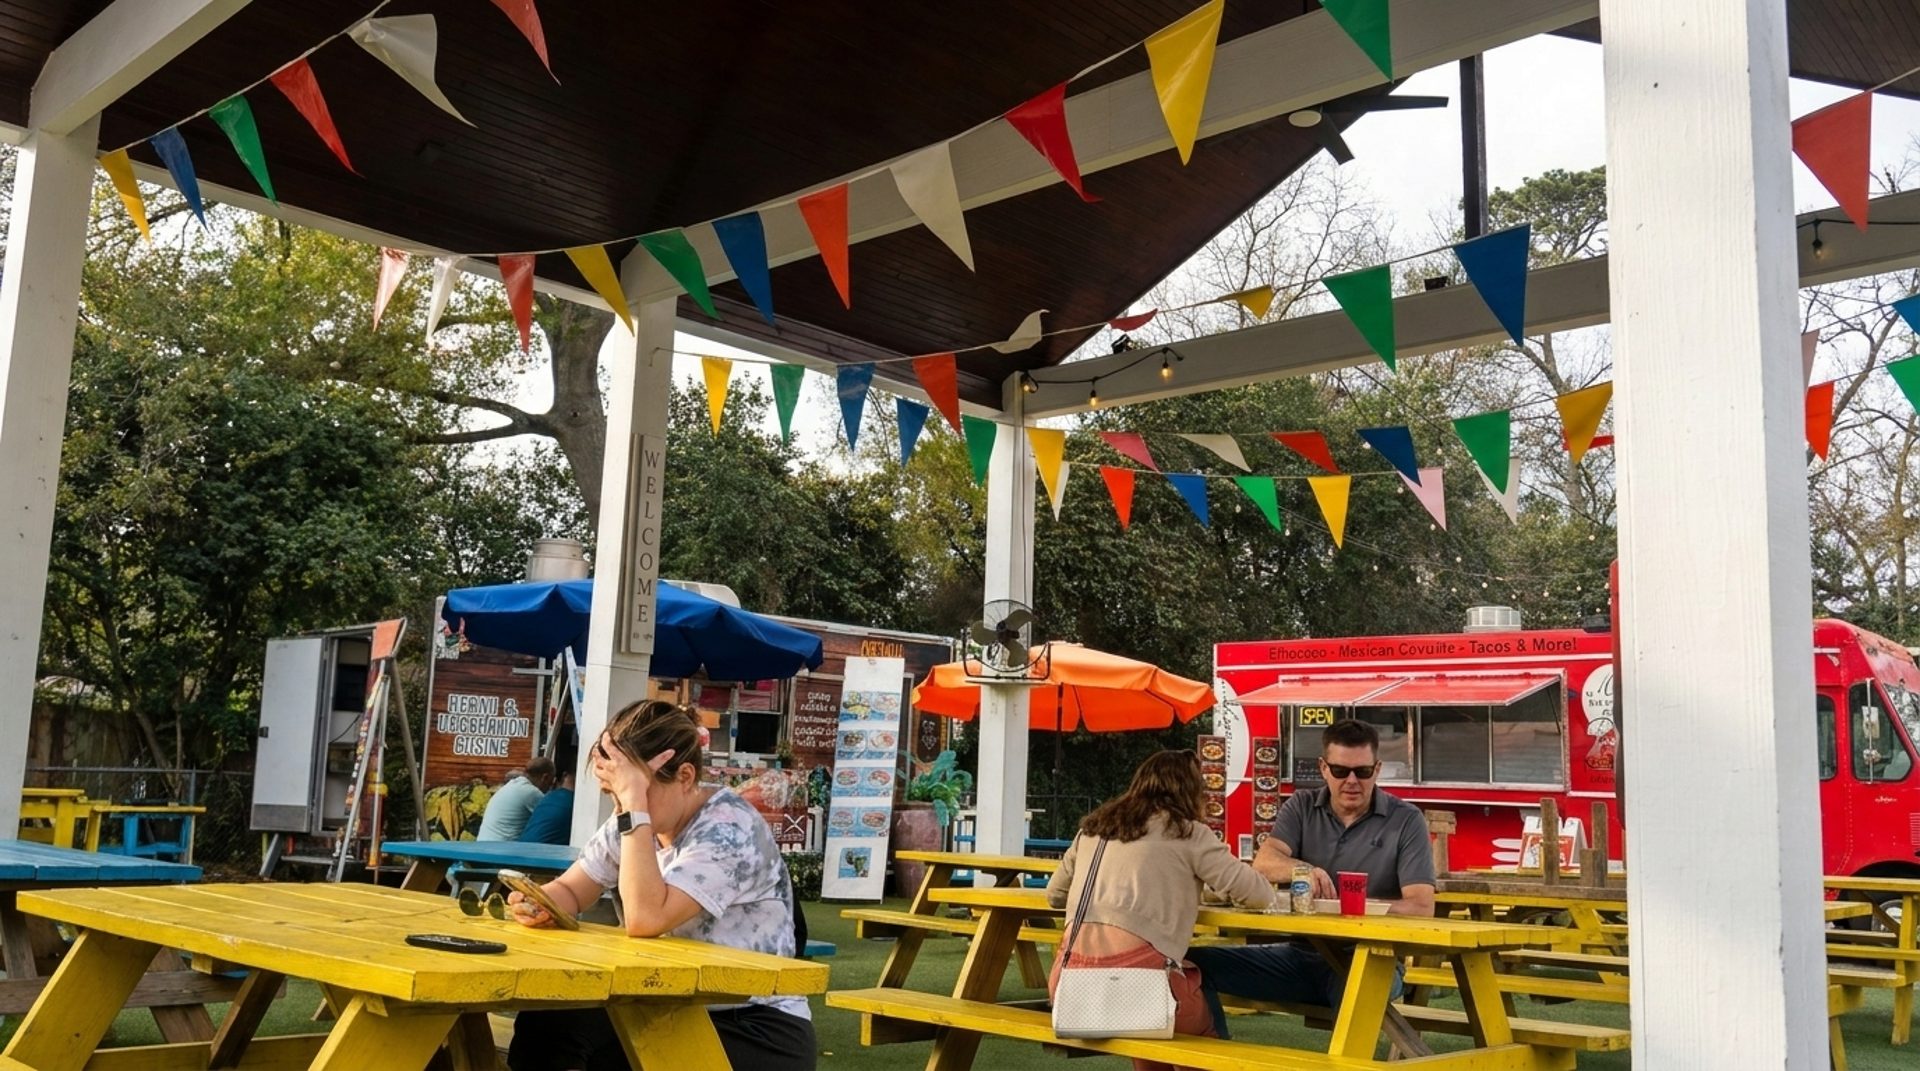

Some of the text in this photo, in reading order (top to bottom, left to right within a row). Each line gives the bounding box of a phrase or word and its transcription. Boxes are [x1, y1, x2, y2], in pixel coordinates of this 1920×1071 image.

[636, 450, 660, 623] WELCOME
[1339, 645, 1394, 657] Mexican
[1469, 640, 1510, 654] Tacos
[1516, 639, 1526, 652] &
[1532, 637, 1577, 650] More!
[504, 698, 519, 718] &
